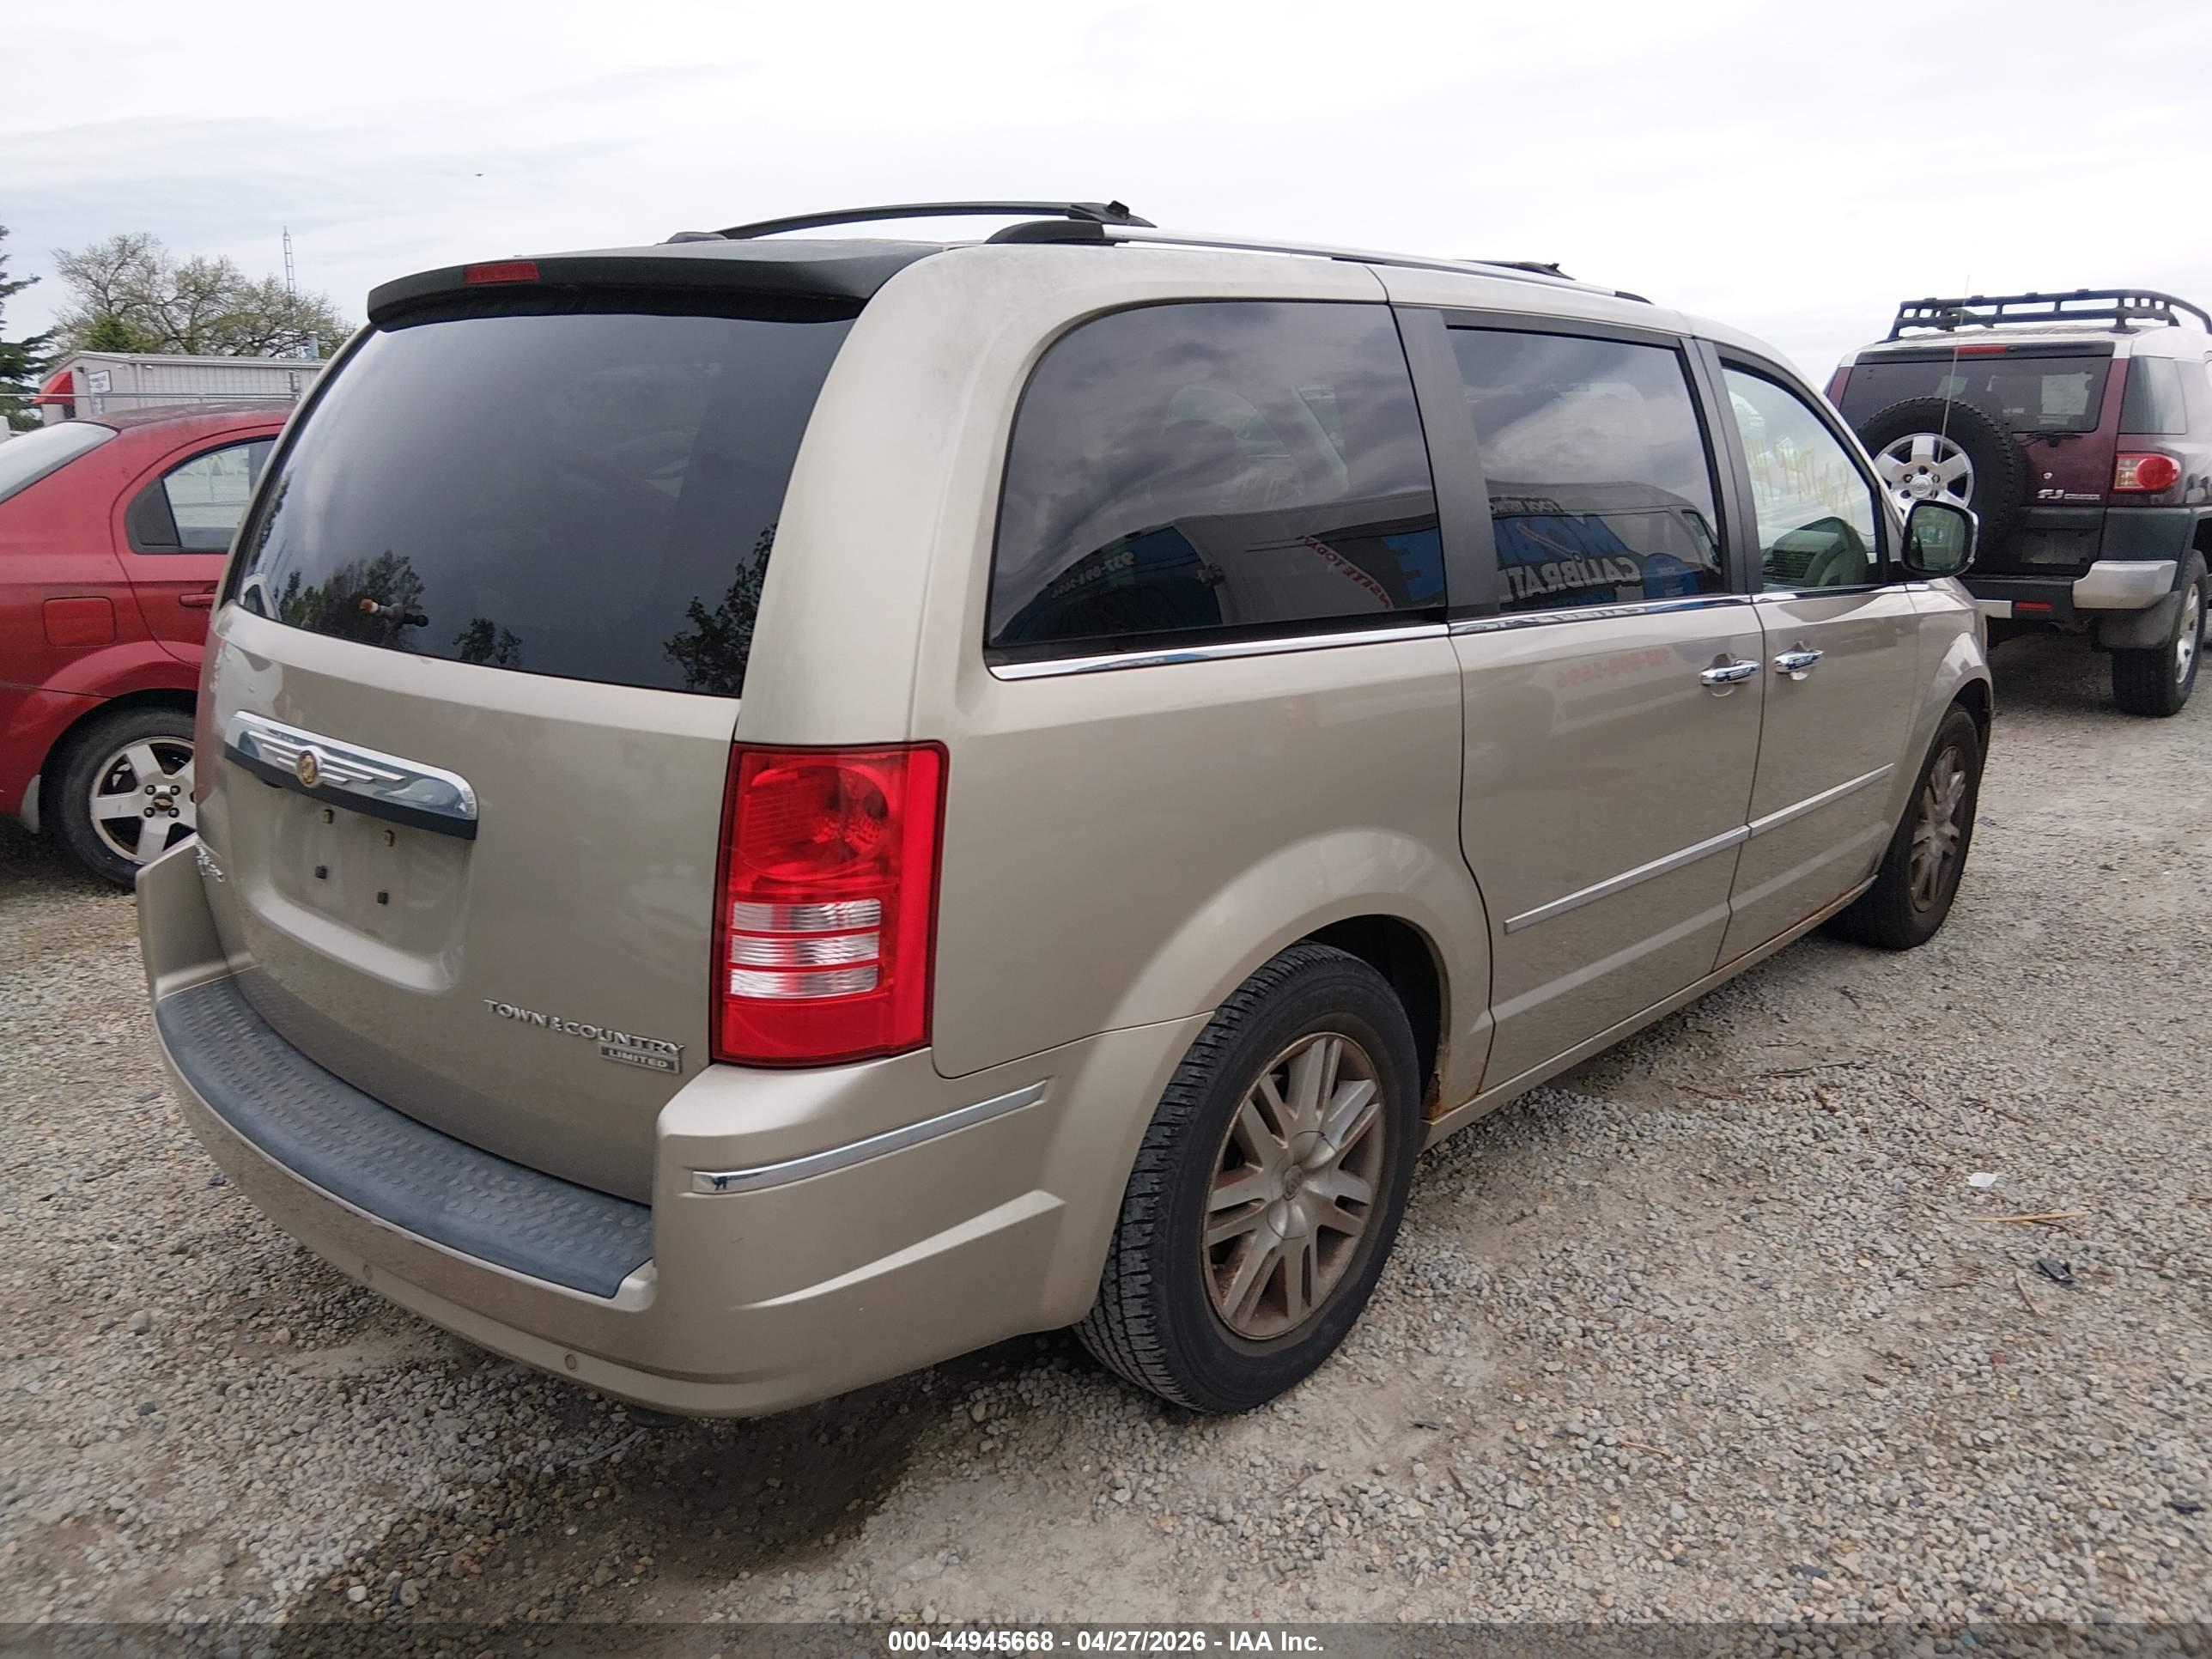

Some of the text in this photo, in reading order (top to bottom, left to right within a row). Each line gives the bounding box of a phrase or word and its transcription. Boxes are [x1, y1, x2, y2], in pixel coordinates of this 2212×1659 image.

[2037, 489, 2064, 499] FJ
[483, 999, 685, 1055] TOWN & COUNTRY
[608, 1048, 668, 1069] LIMITED
